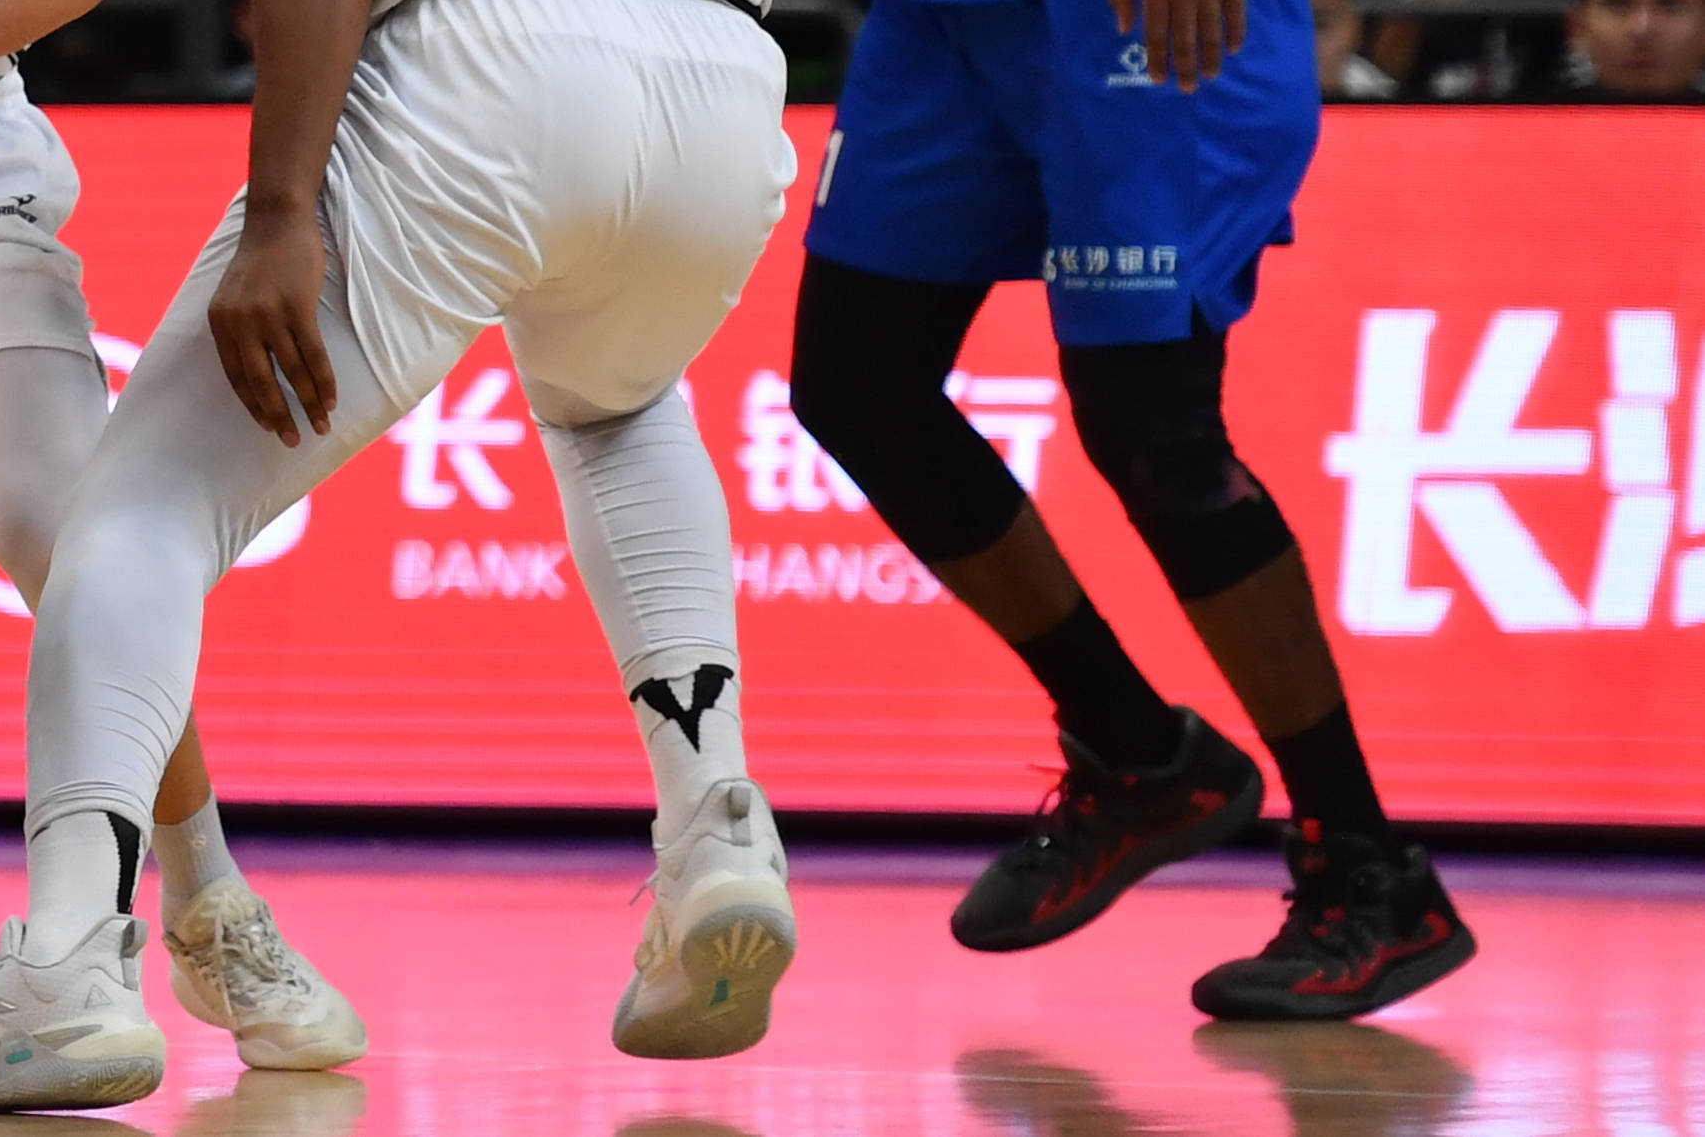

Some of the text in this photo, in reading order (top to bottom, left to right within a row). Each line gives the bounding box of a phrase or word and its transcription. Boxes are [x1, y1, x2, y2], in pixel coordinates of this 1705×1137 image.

[1060, 246, 1177, 275] 长沙银行
[391, 540, 569, 602] BANK
